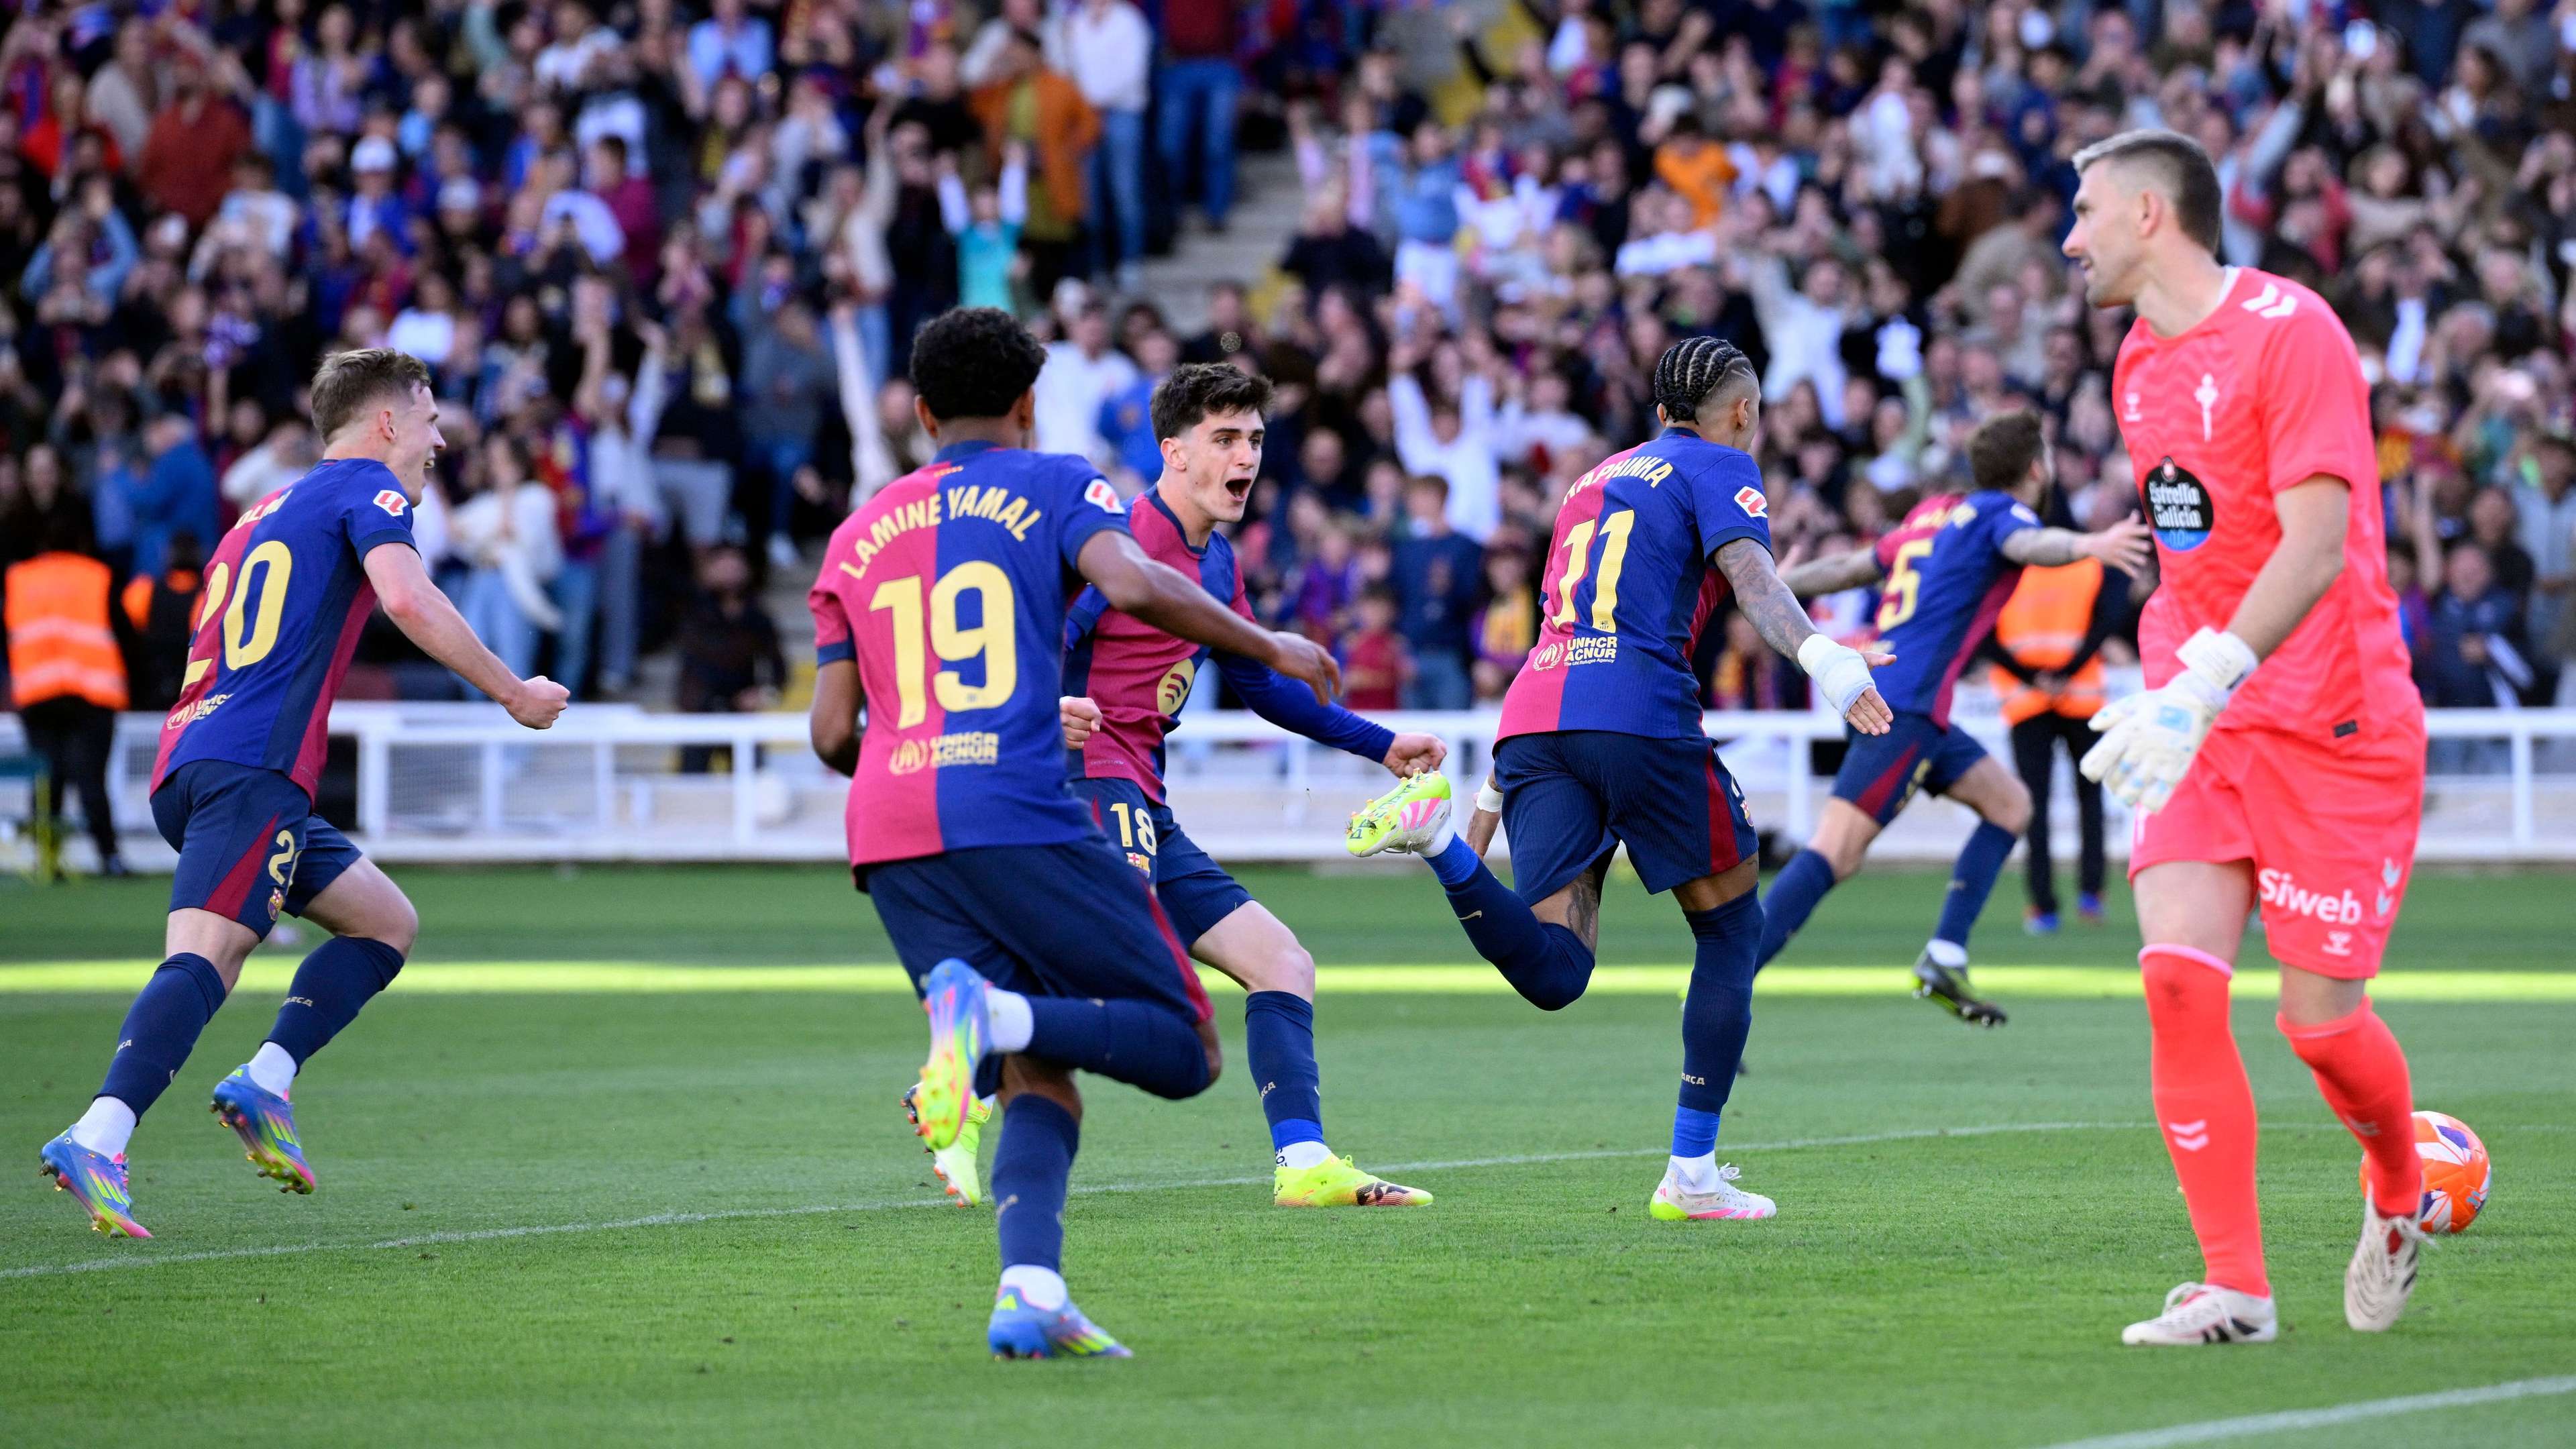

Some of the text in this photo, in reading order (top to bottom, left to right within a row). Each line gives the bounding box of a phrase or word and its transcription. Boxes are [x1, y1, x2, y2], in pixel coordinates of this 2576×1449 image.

[839, 485, 1041, 580] LAMINE YAMAL
[2154, 504, 2203, 528] Galicia
[1552, 509, 1635, 633] 11
[1877, 539, 1934, 631] 5
[180, 540, 292, 694] 20
[869, 560, 1017, 730] 19
[1566, 636, 1617, 651] UNHCR
[1564, 647, 1617, 662] ACNUR
[929, 731, 998, 749] UNHCR
[1110, 803, 1157, 856] 18
[2258, 868, 2362, 926] Siweb
